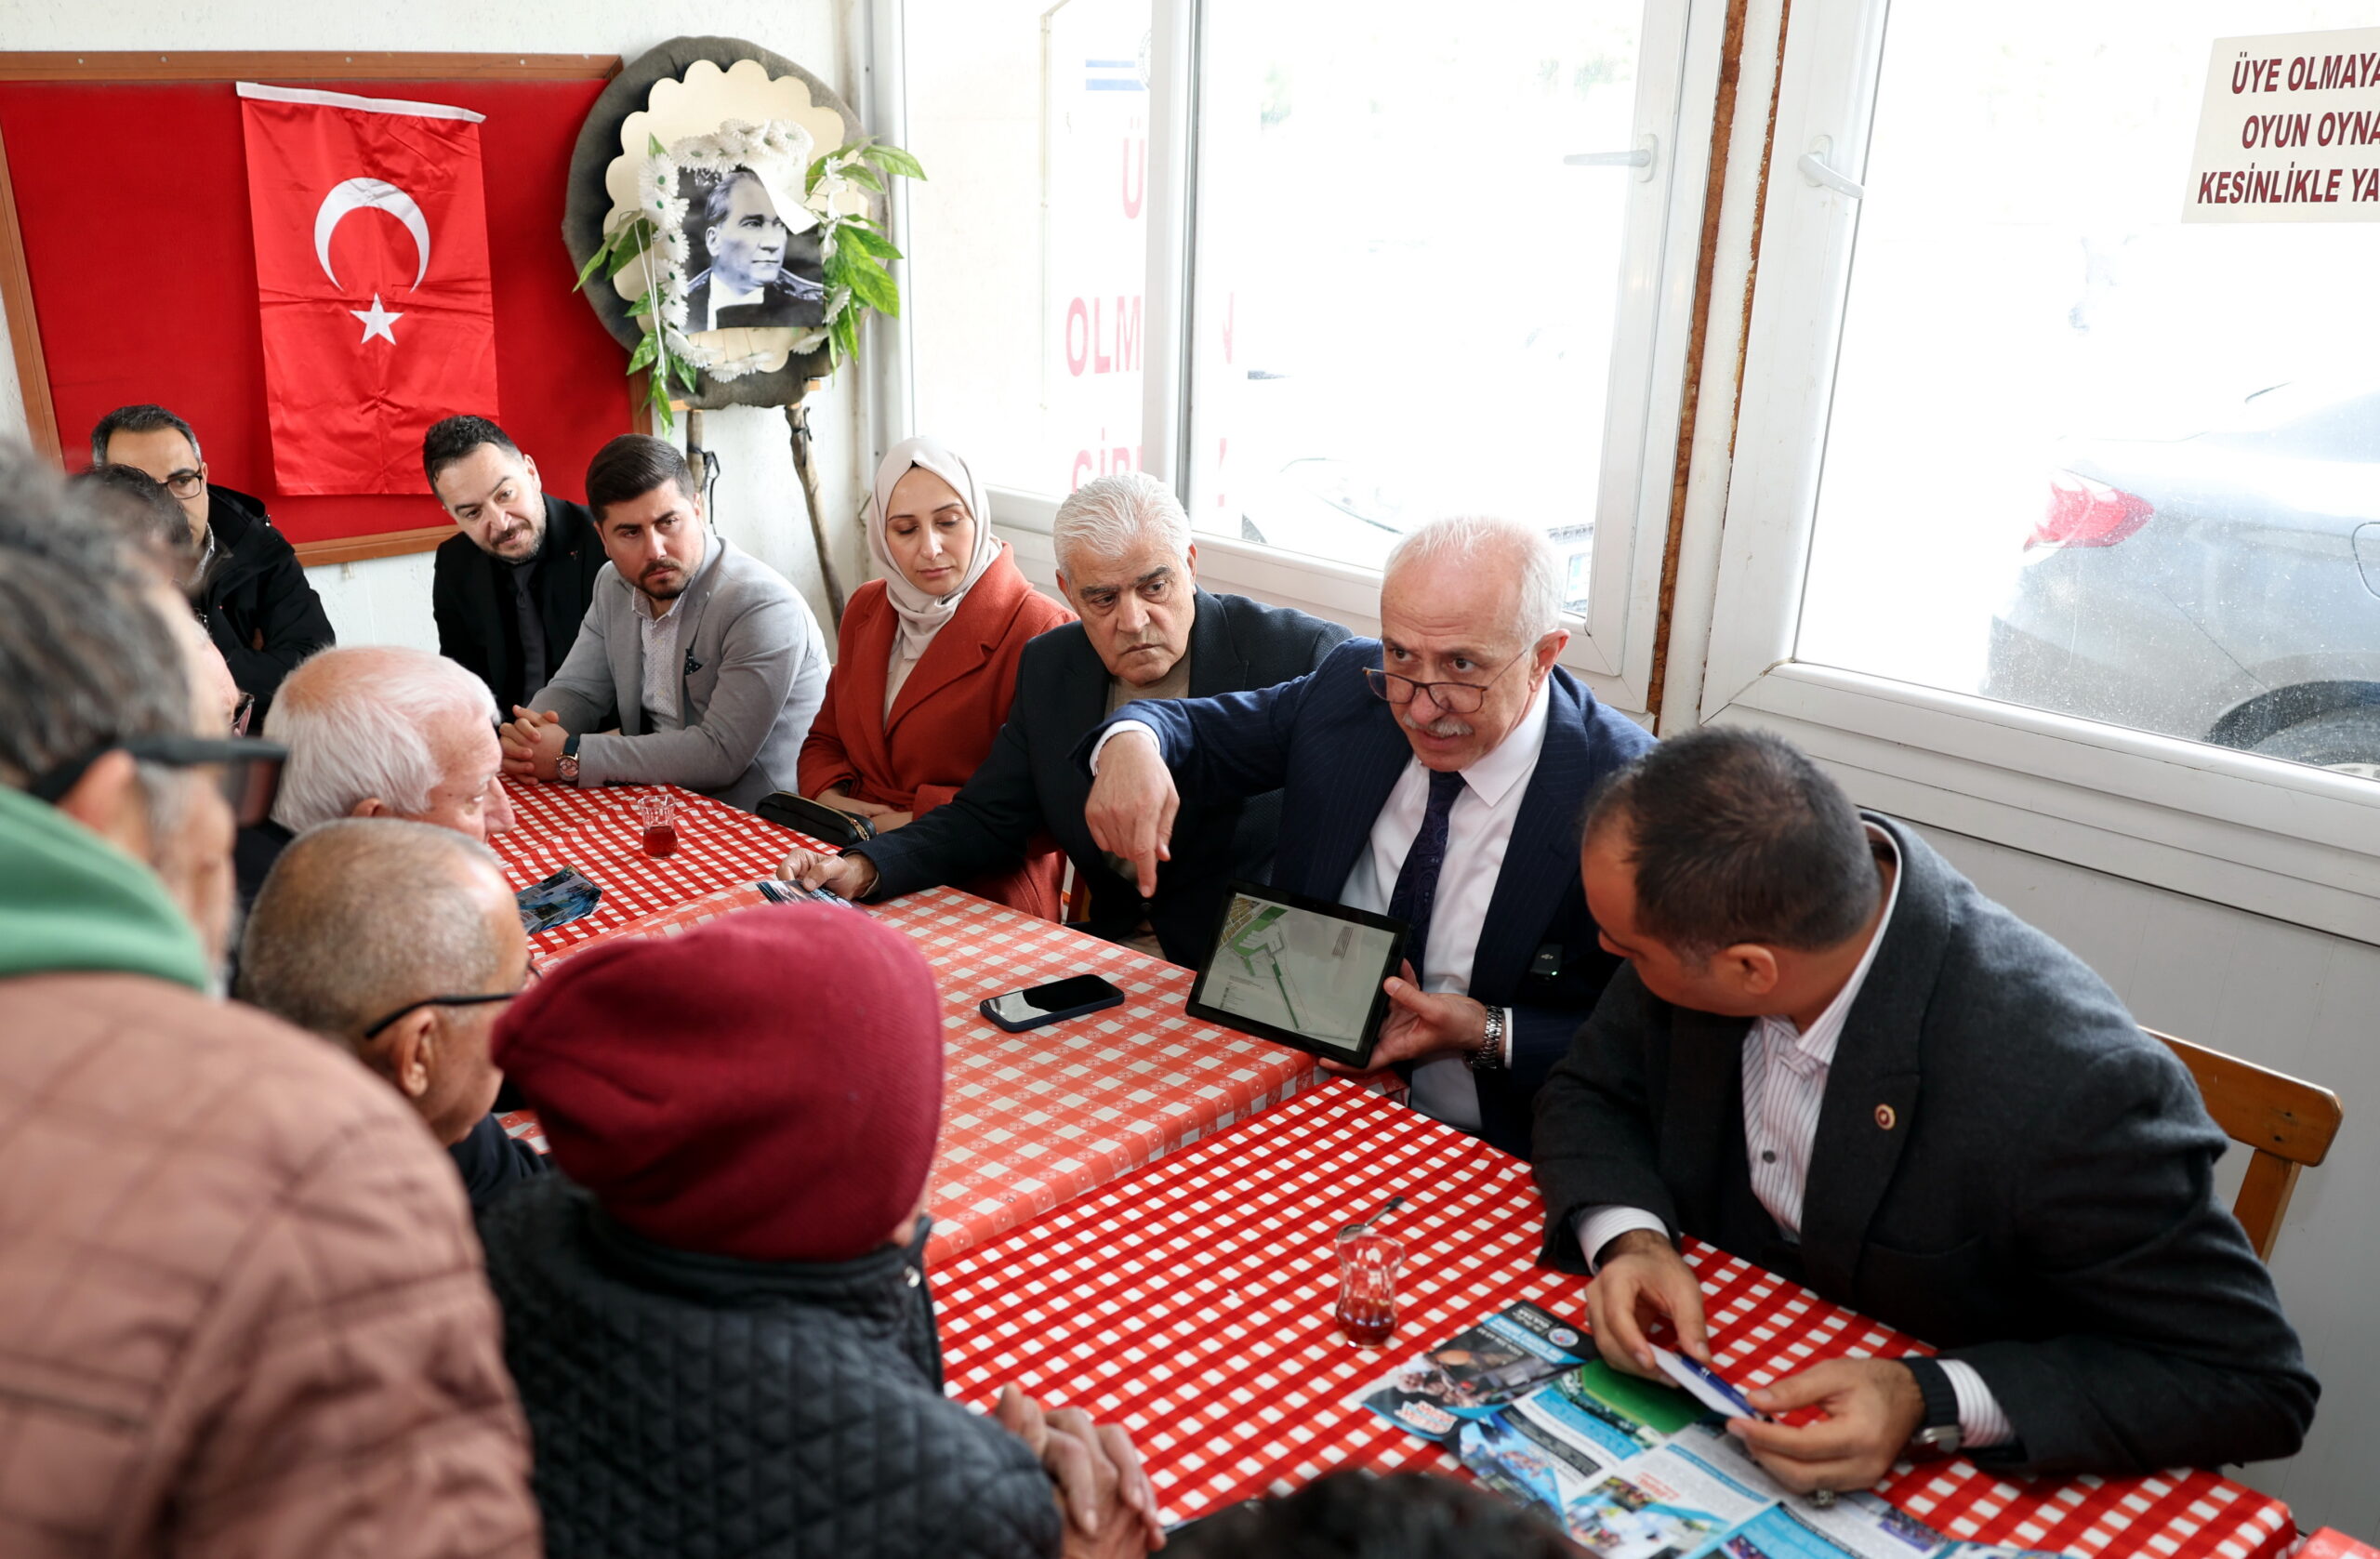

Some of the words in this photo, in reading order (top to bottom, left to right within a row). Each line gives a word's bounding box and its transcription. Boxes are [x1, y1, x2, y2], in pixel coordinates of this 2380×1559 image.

[2231, 51, 2283, 94] ÜYE
[2241, 112, 2312, 149] OYUN
[2317, 111, 2380, 147] OYNA
[2197, 161, 2344, 204] KESİNLİKLE
[2351, 168, 2380, 203] YA
